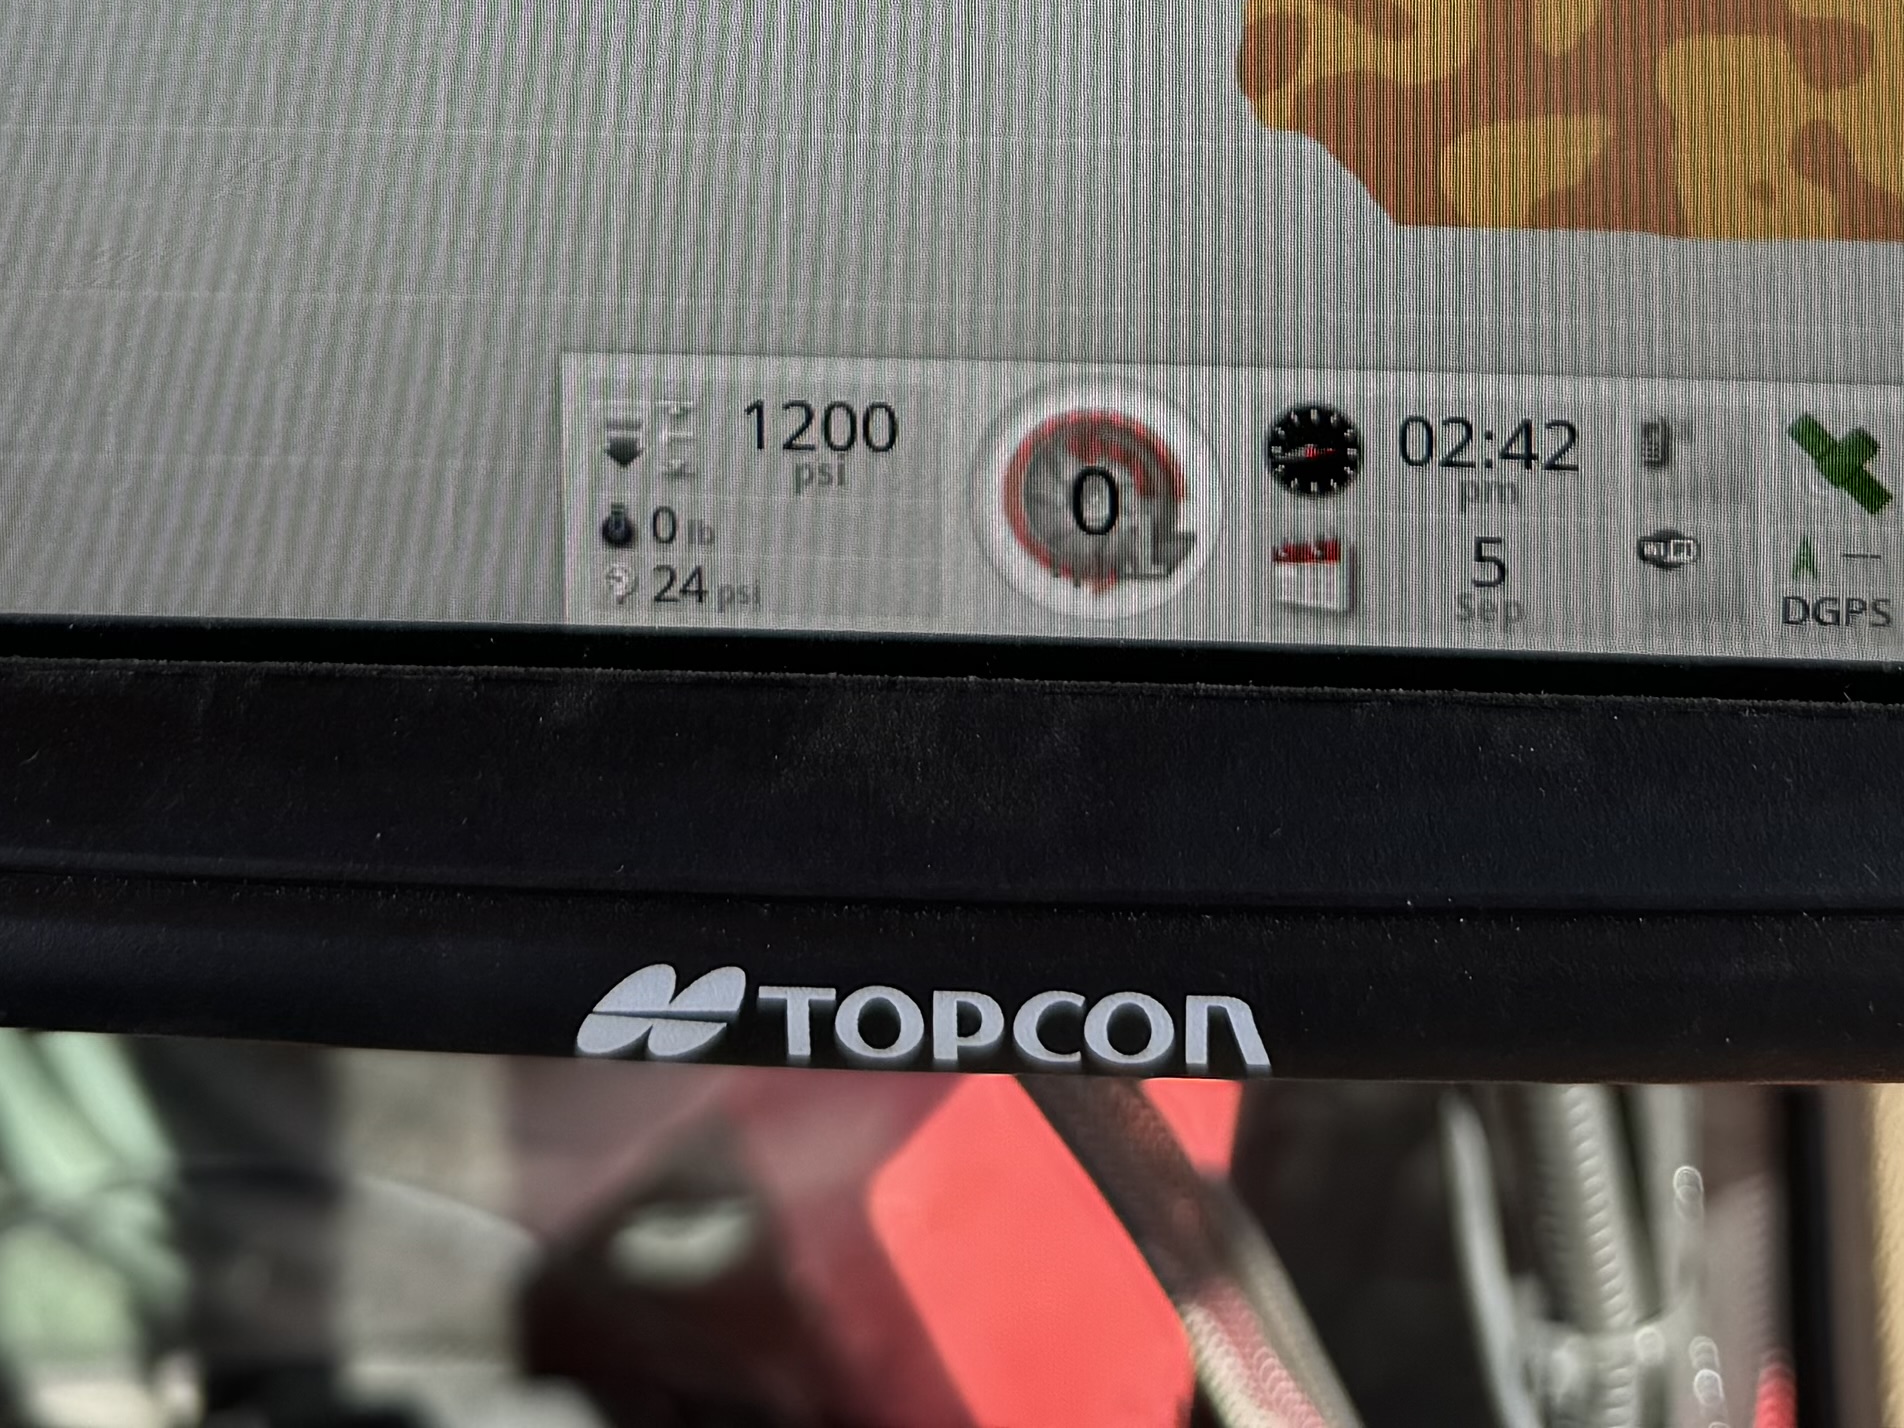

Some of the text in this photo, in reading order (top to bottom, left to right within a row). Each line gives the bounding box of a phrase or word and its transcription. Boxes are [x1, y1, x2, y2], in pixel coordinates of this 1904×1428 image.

[744, 399, 898, 453] 1200
[1399, 416, 1579, 473] 02:42
[796, 459, 847, 494] psi
[1072, 465, 1120, 535] 0
[653, 506, 676, 544] 0
[653, 564, 708, 603] 24
[1474, 537, 1506, 589] 5
[1455, 592, 1523, 634] Sep
[1782, 596, 1892, 629] DGPS
[758, 986, 1271, 1067] TOPCON
